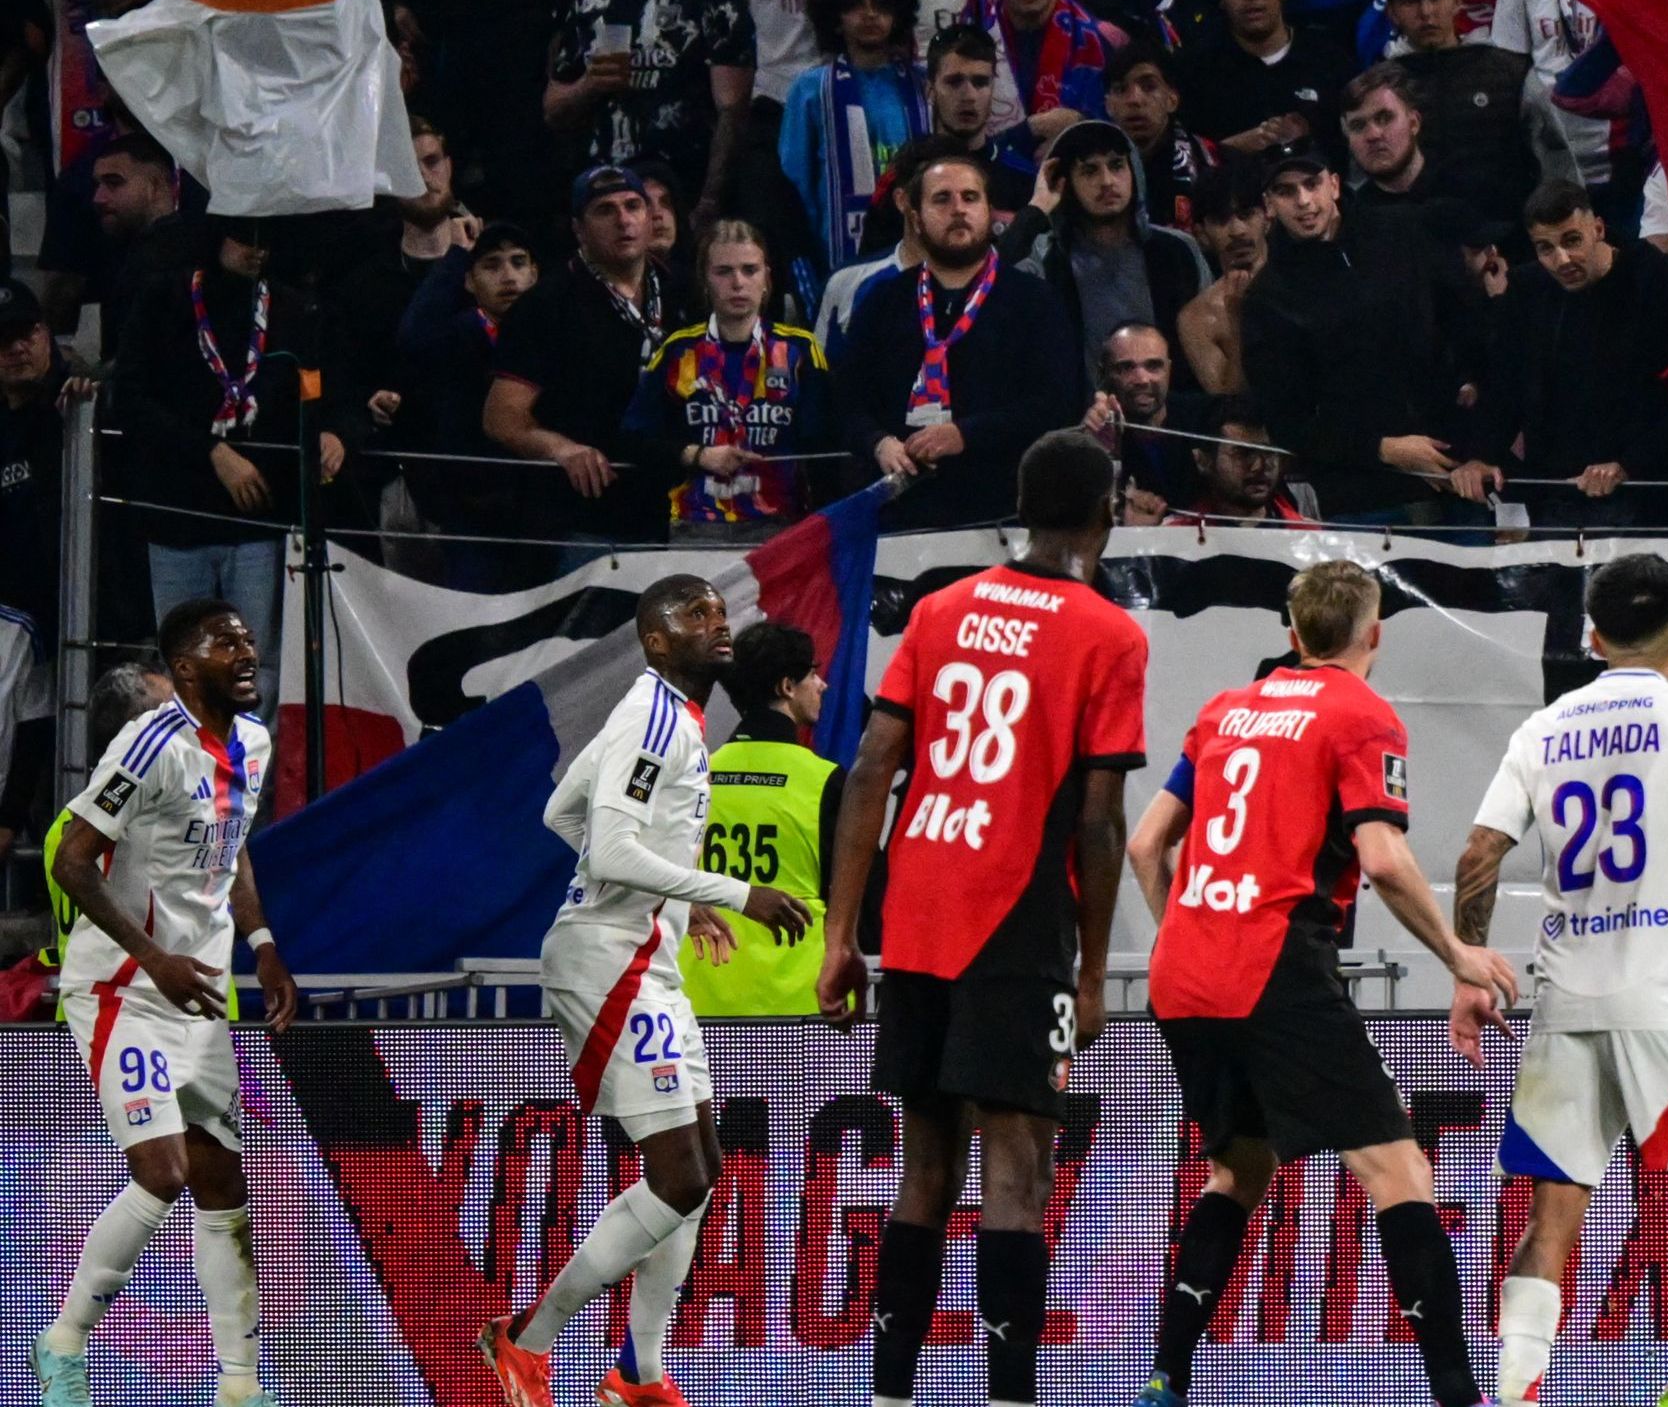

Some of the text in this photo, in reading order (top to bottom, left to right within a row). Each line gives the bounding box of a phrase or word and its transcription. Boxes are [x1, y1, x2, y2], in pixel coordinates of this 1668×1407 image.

[974, 581, 1064, 613] WINAMAX
[957, 613, 1039, 658] CISSE
[929, 661, 1031, 785] 38
[1541, 721, 1661, 767] T.ALMADA
[1206, 747, 1262, 856] 3
[703, 823, 779, 885] 635
[1551, 773, 1647, 893] 23
[630, 1012, 682, 1064] 22
[120, 1047, 172, 1093] 98
